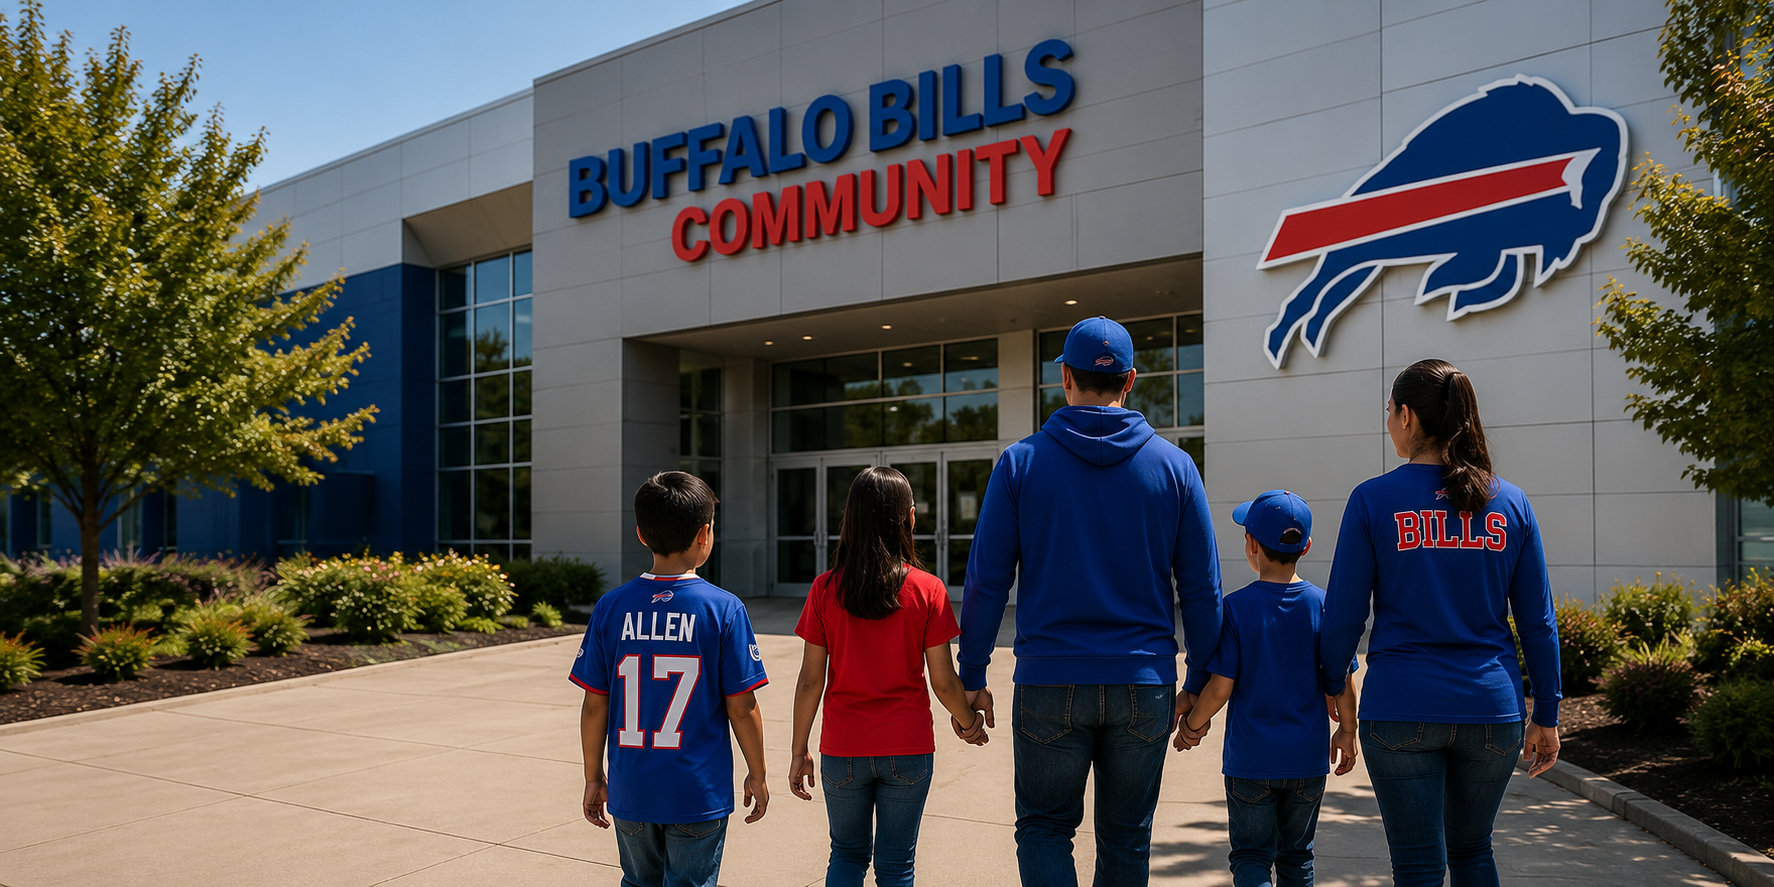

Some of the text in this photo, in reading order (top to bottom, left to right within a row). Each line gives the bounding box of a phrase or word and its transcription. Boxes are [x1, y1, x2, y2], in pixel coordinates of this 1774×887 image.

[568, 38, 1076, 218] BUFFALO BILLS
[671, 127, 1073, 262] COMMUNITY
[1393, 510, 1507, 552] BILLS
[621, 611, 696, 642] ALLEN
[617, 653, 702, 750] 17
